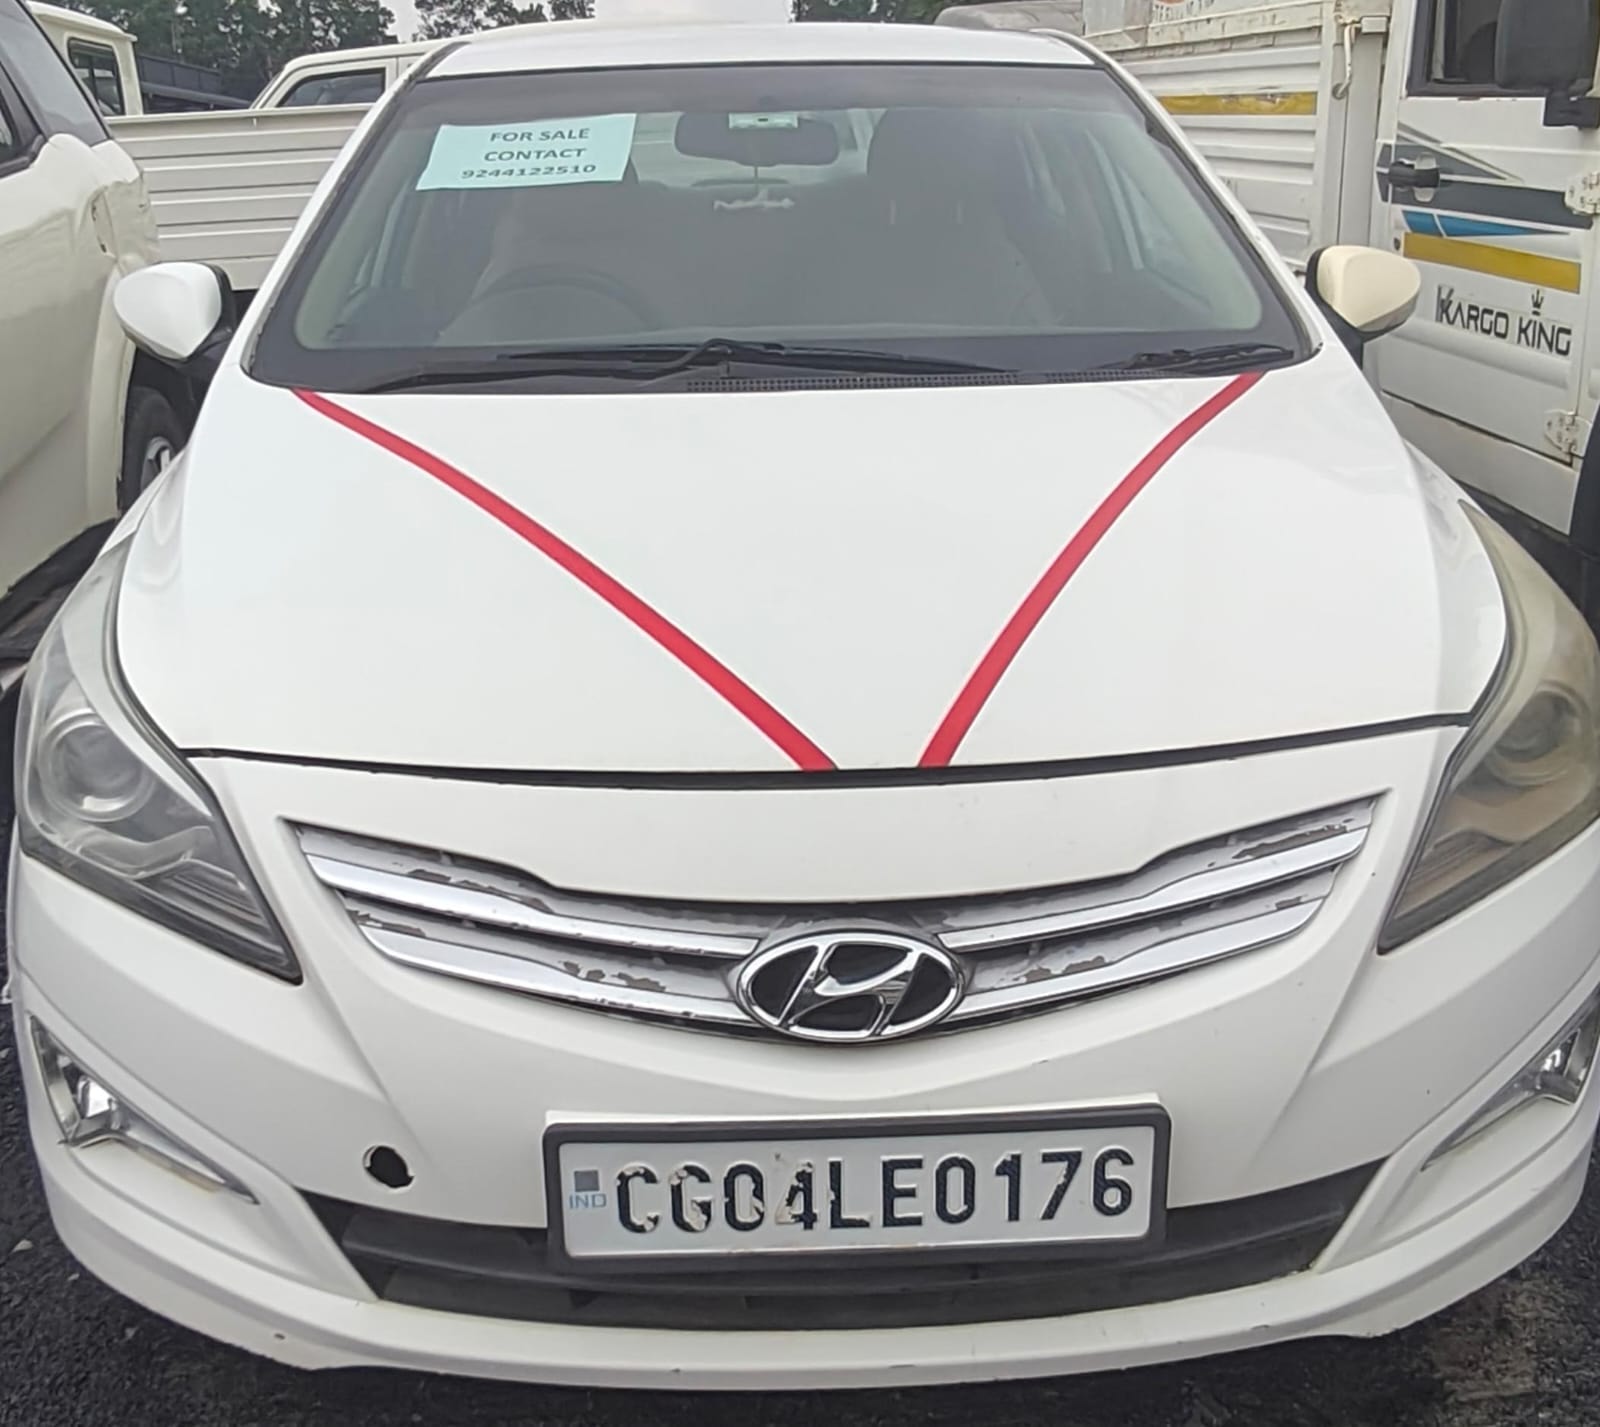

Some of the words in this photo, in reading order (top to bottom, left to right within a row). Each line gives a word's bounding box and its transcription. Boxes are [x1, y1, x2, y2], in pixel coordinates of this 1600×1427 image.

[490, 130, 533, 142] FOR
[538, 128, 590, 140] SALE
[484, 148, 587, 161] CONTACT
[462, 164, 596, 179] 9244122510
[1517, 312, 1572, 356] KING
[617, 1146, 1136, 1234] CG04LE0176
[569, 1193, 608, 1211] IND
